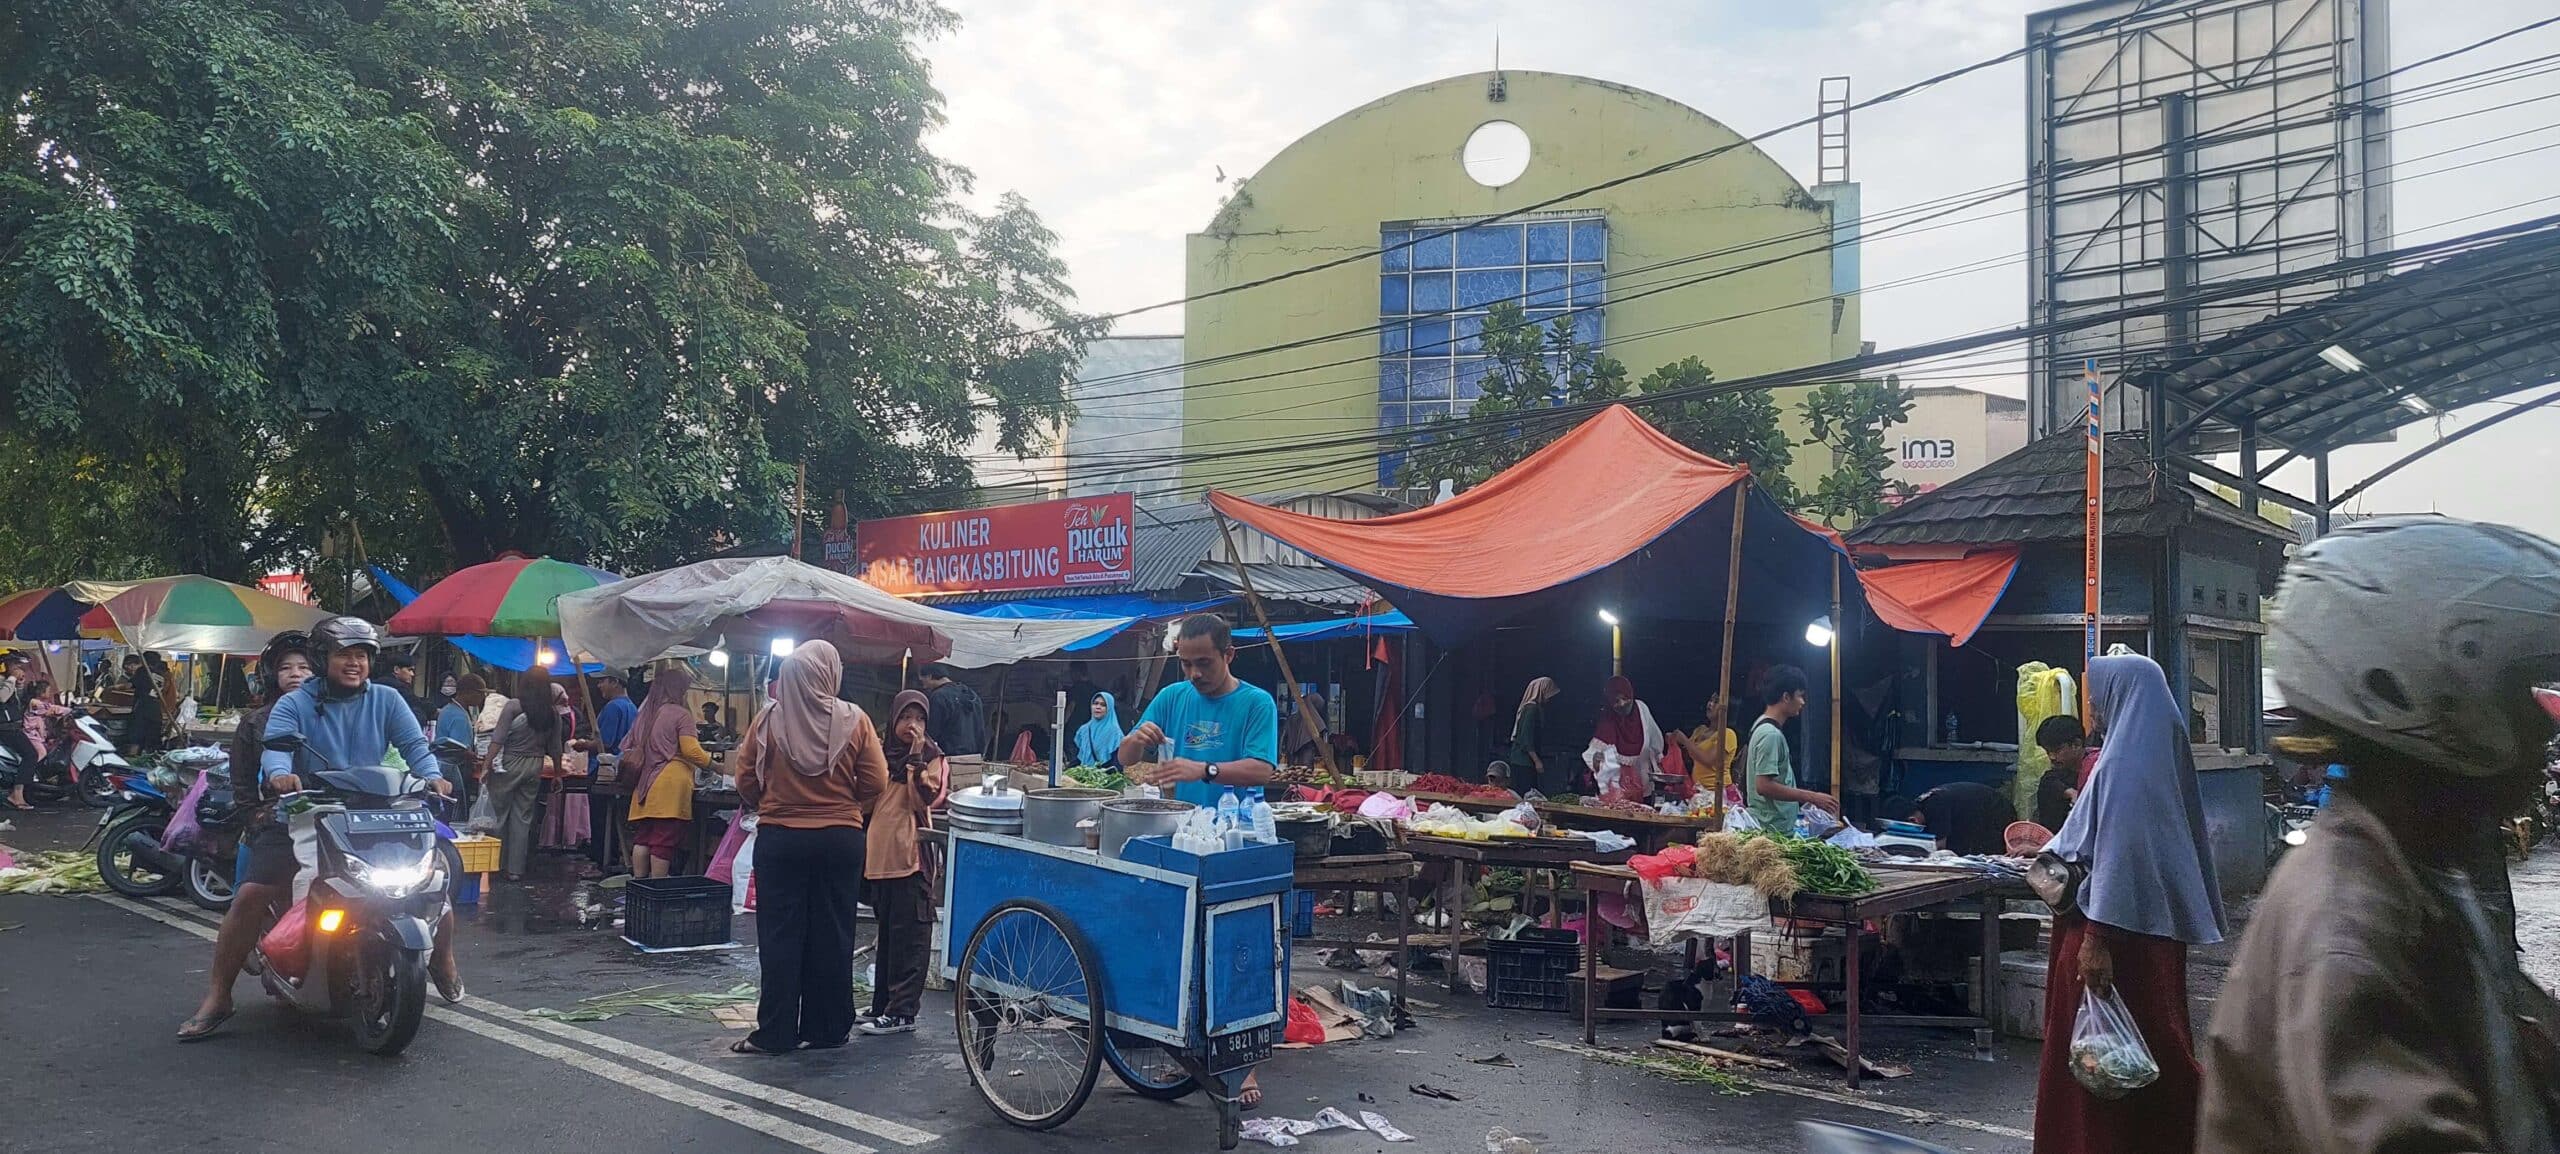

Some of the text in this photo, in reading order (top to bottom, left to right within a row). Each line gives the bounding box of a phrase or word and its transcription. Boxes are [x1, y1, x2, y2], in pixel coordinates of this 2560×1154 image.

[920, 518, 990, 551] KULINER
[1068, 518, 1128, 564] pucuk
[914, 546, 1059, 584] RANGKASBITUNG
[1078, 547, 1125, 569] HARUM
[352, 814, 361, 823] A
[1211, 1028, 1270, 1057] A 5821 NB
